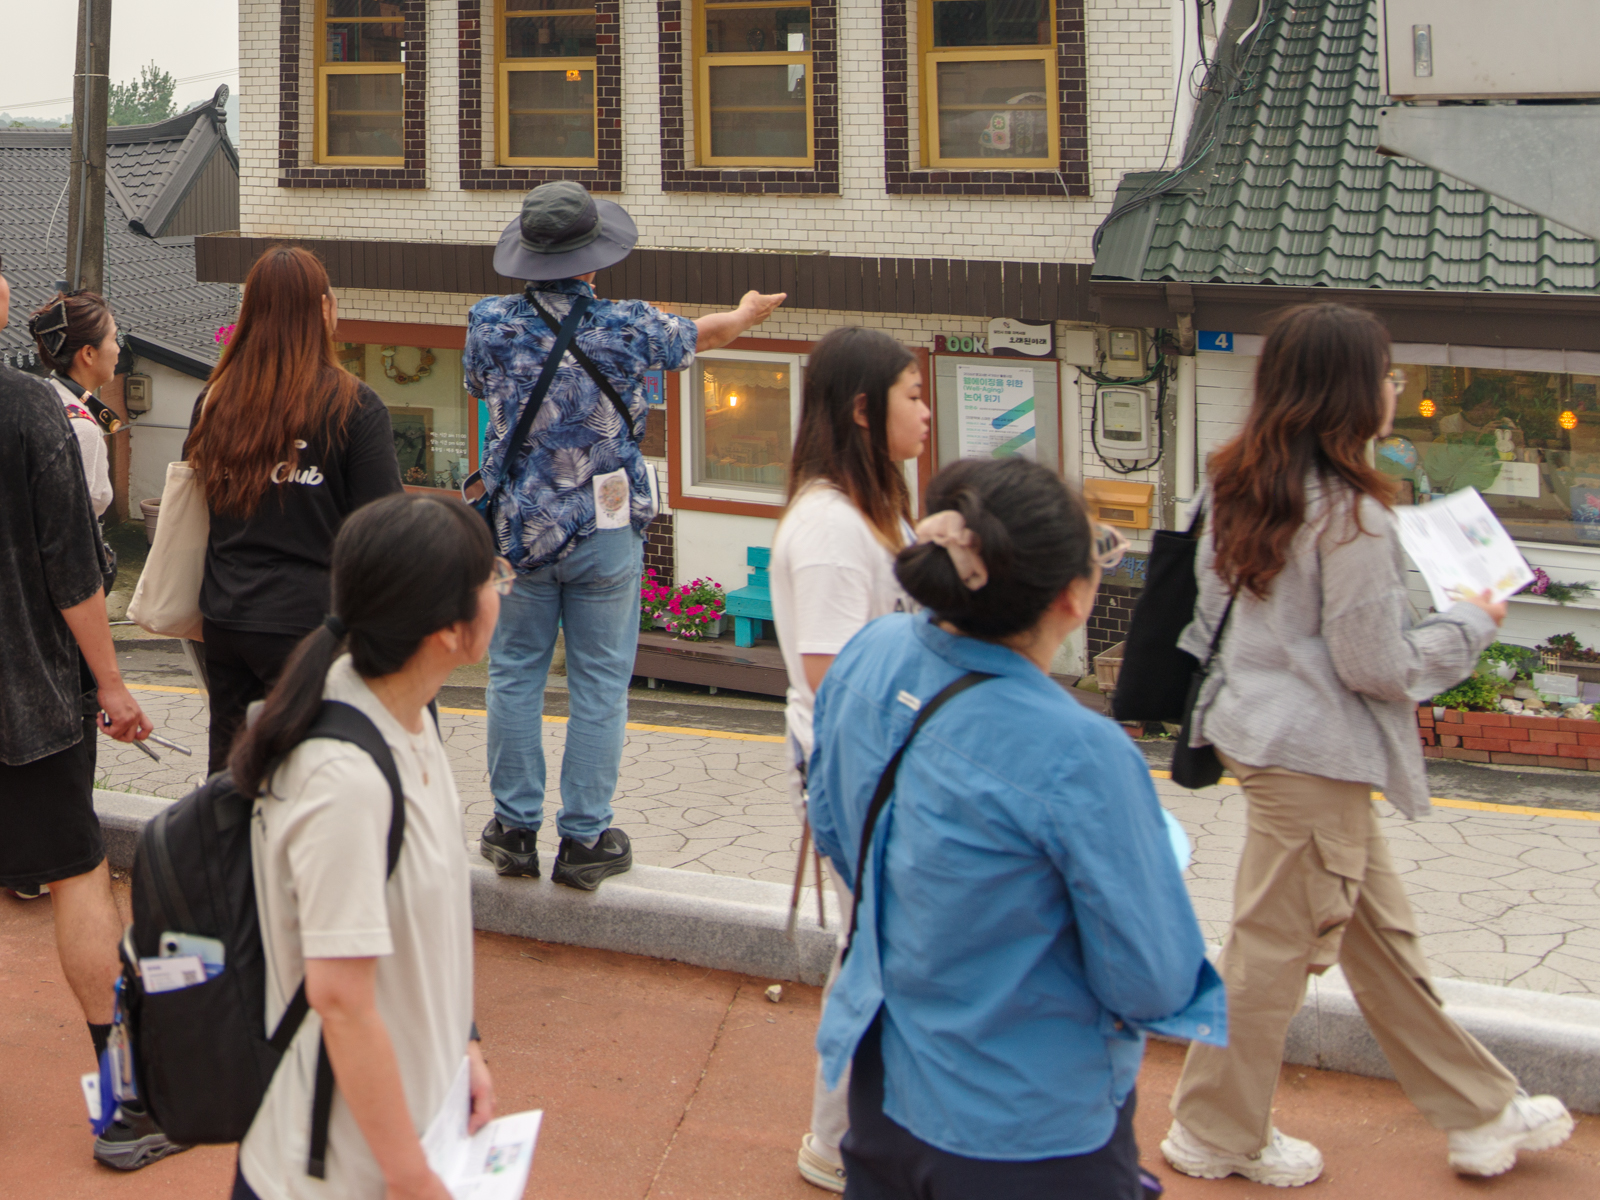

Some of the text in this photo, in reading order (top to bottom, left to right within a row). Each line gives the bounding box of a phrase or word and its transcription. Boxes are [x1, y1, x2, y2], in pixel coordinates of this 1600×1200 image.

[934, 335, 986, 353] BOOK
[1215, 333, 1229, 348] 4
[1006, 379, 1023, 388] 위한
[964, 393, 1000, 403] 논어 읽기
[270, 461, 324, 485] Club
